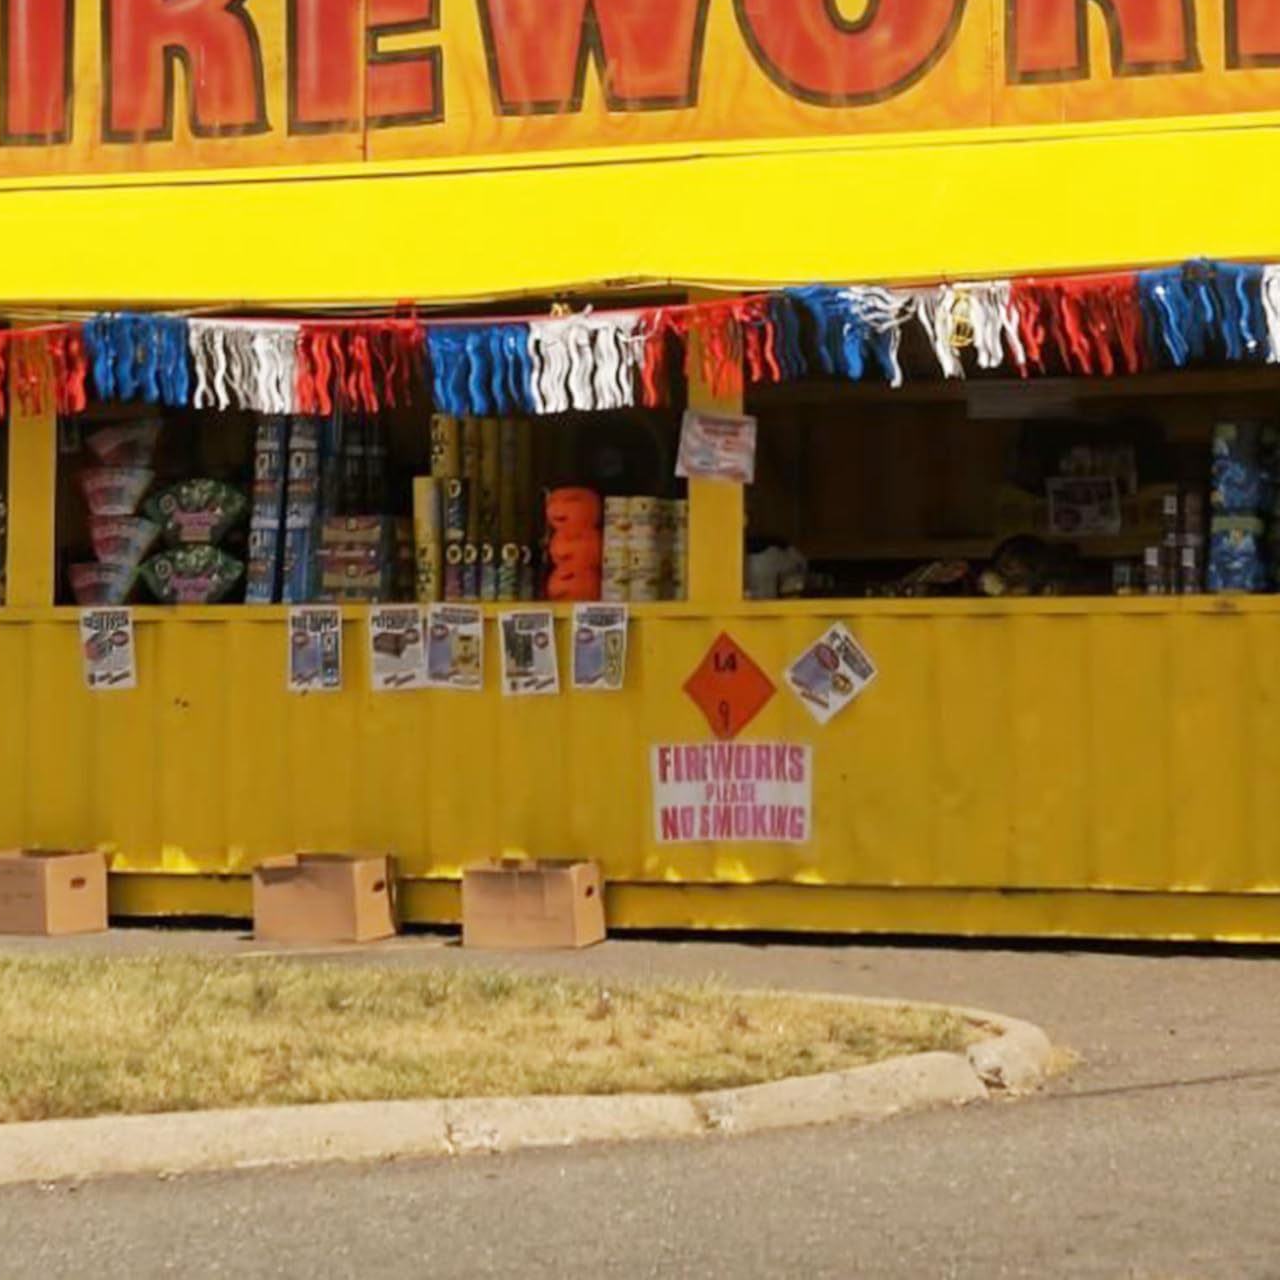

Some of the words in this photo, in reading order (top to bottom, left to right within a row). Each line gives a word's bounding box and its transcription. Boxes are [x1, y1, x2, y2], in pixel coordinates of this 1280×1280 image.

[658, 743, 805, 784] FIREWORKS
[661, 805, 695, 840] NO
[699, 804, 805, 840] SMOKING
